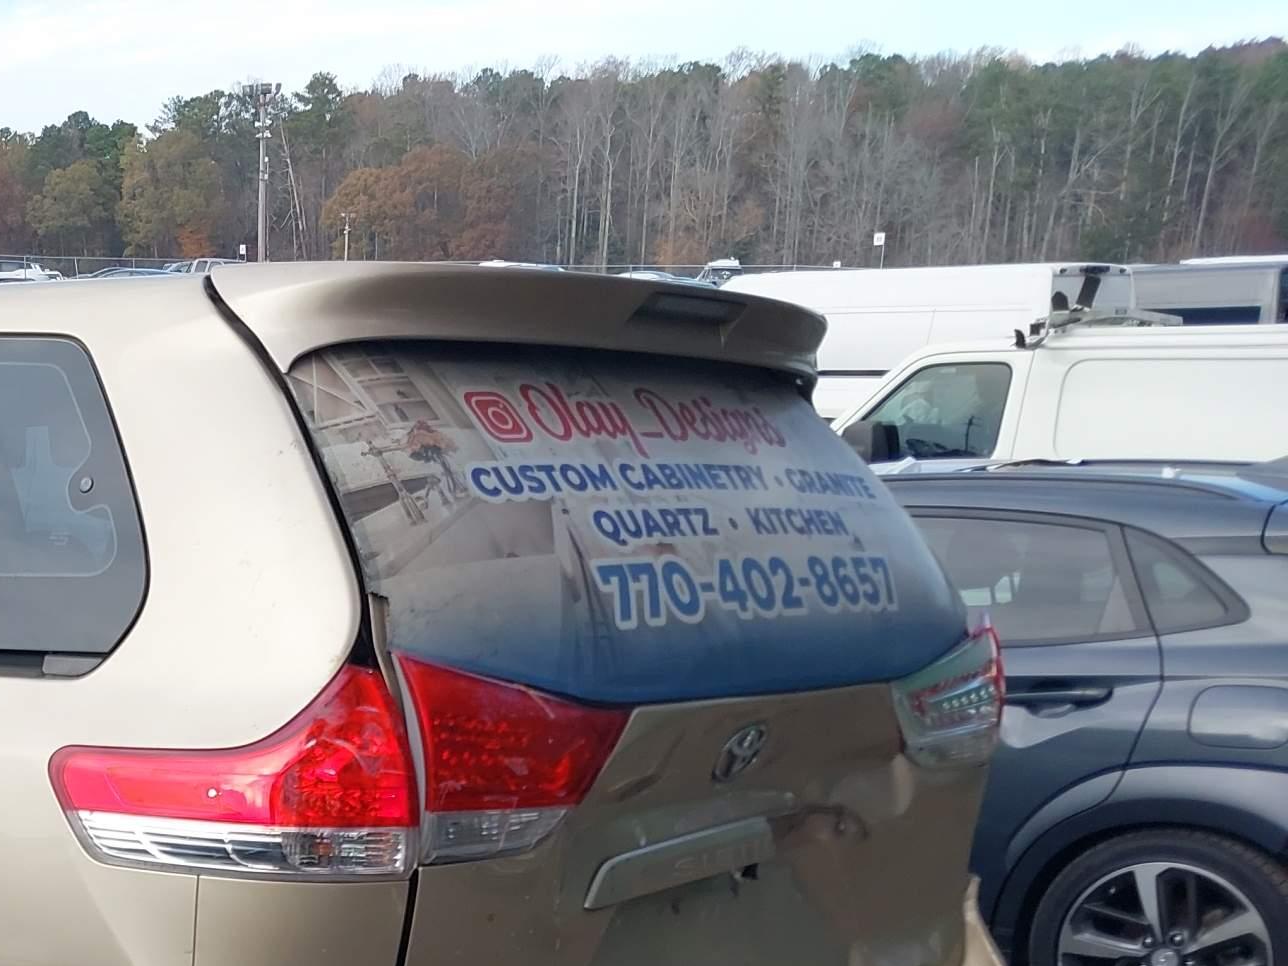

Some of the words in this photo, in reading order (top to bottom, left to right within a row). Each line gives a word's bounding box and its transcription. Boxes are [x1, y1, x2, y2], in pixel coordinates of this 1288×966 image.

[470, 462, 617, 498] CUSTOM
[618, 462, 768, 493] CABINETRY
[785, 468, 876, 499] GRANITE
[592, 507, 720, 546] QUARTZ
[745, 507, 851, 536] KITCHEN
[595, 555, 897, 623] 770-402-8657
